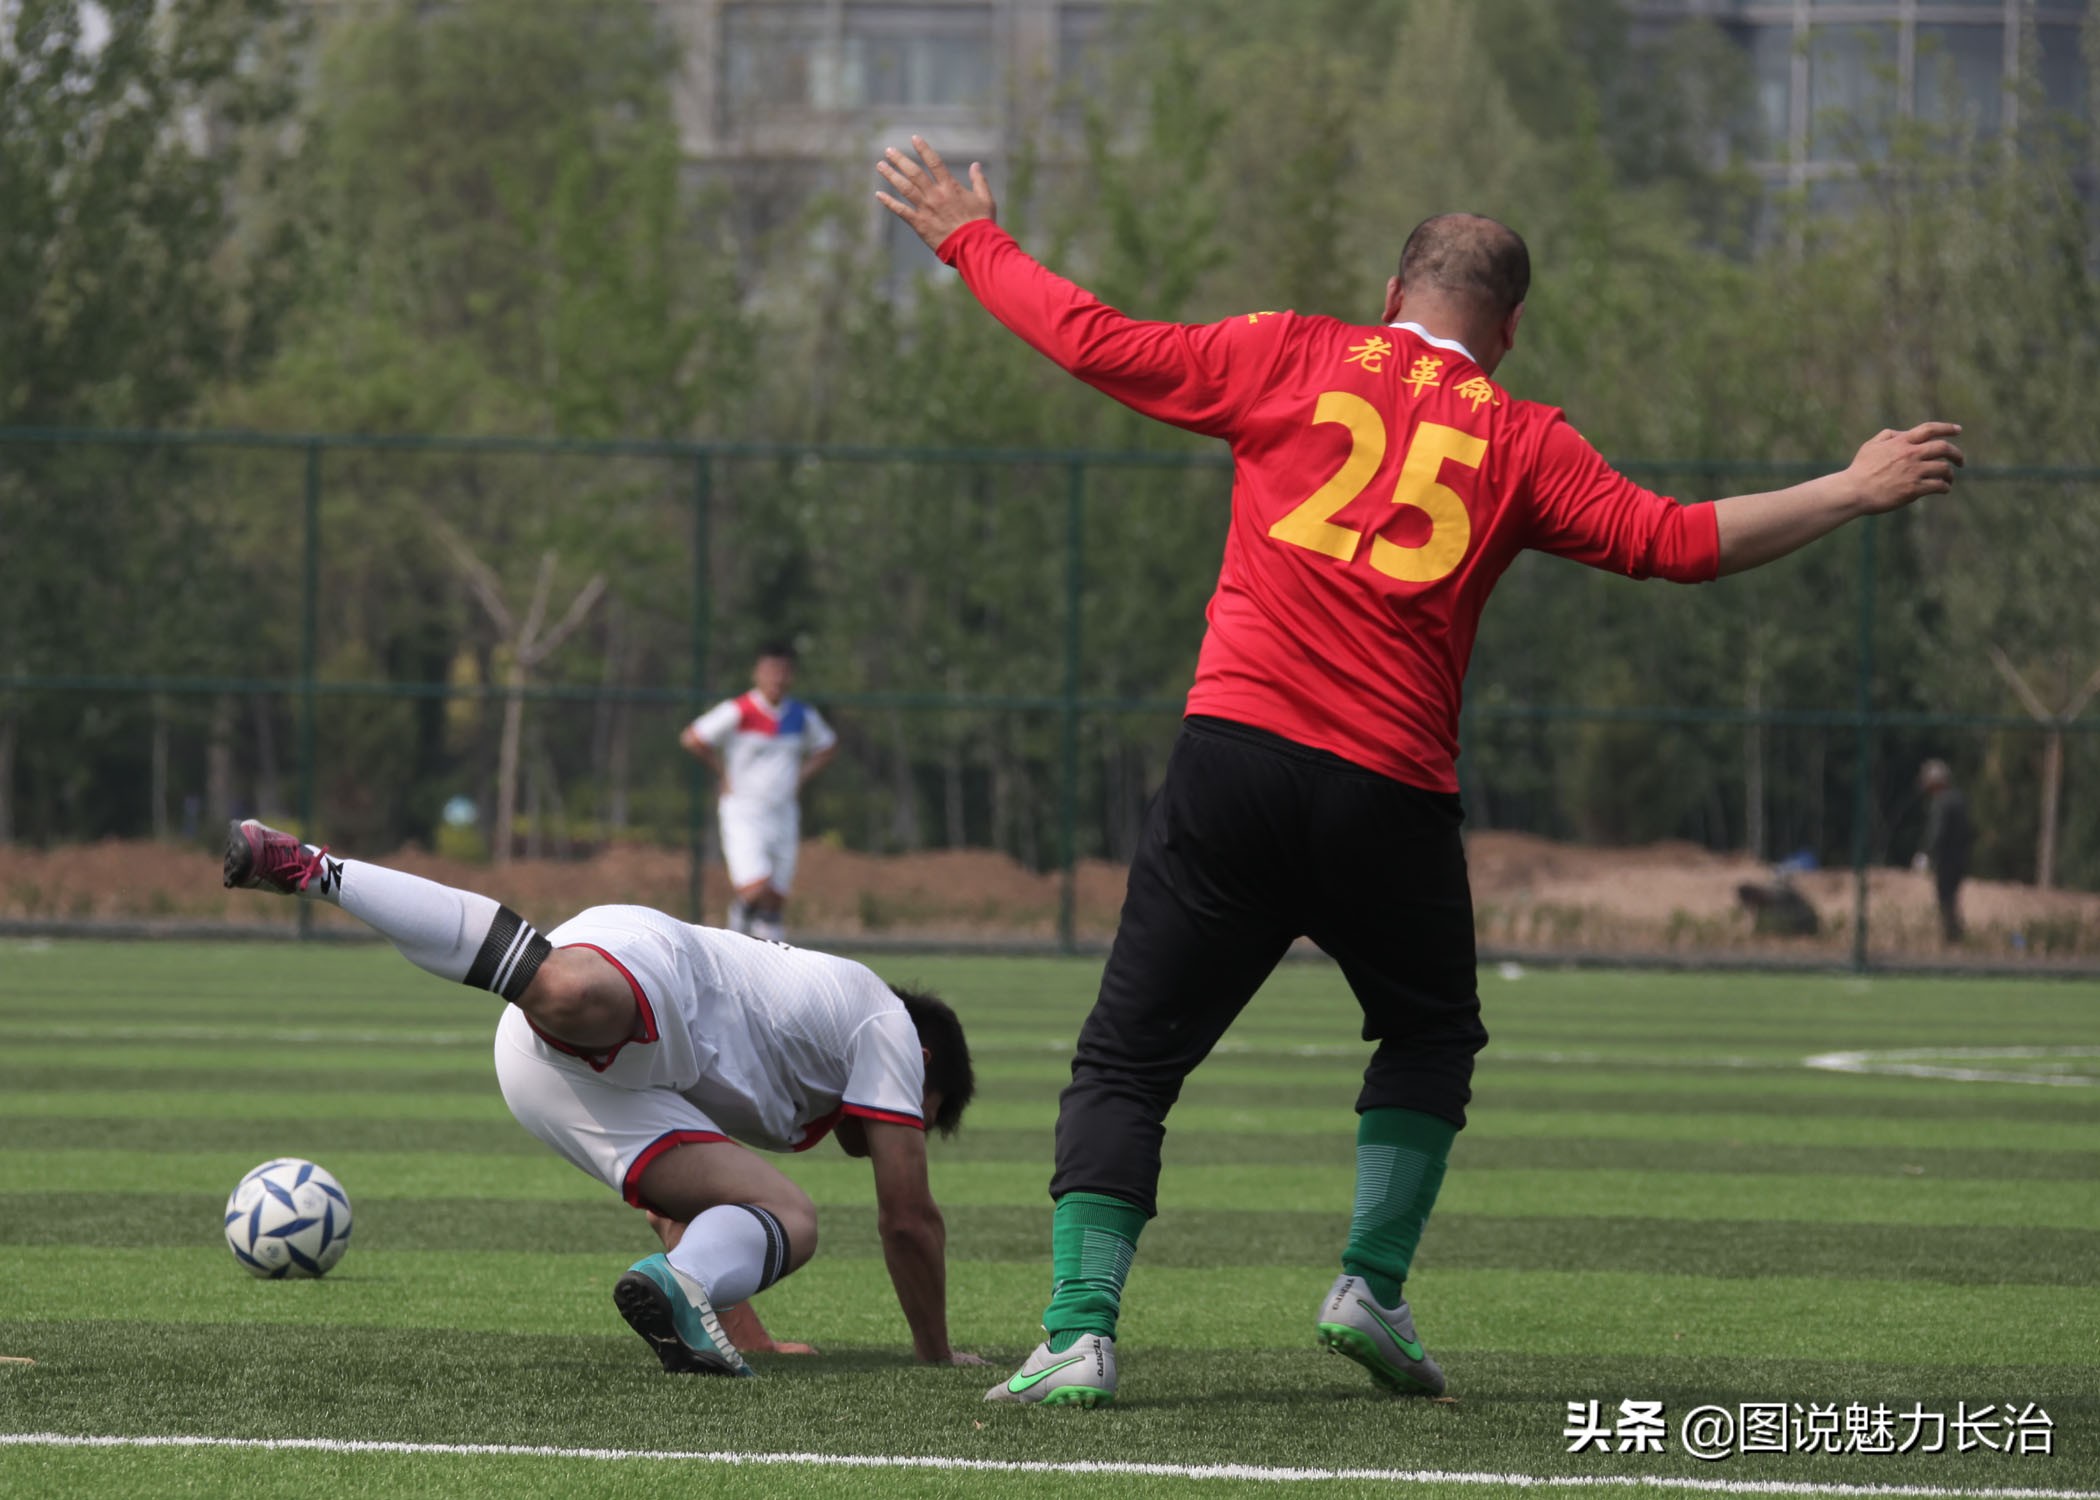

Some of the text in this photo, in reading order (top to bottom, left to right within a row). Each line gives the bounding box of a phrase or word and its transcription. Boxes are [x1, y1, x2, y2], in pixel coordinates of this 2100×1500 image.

[1344, 335, 1500, 413] 老革命
[1268, 391, 1488, 582] 25
